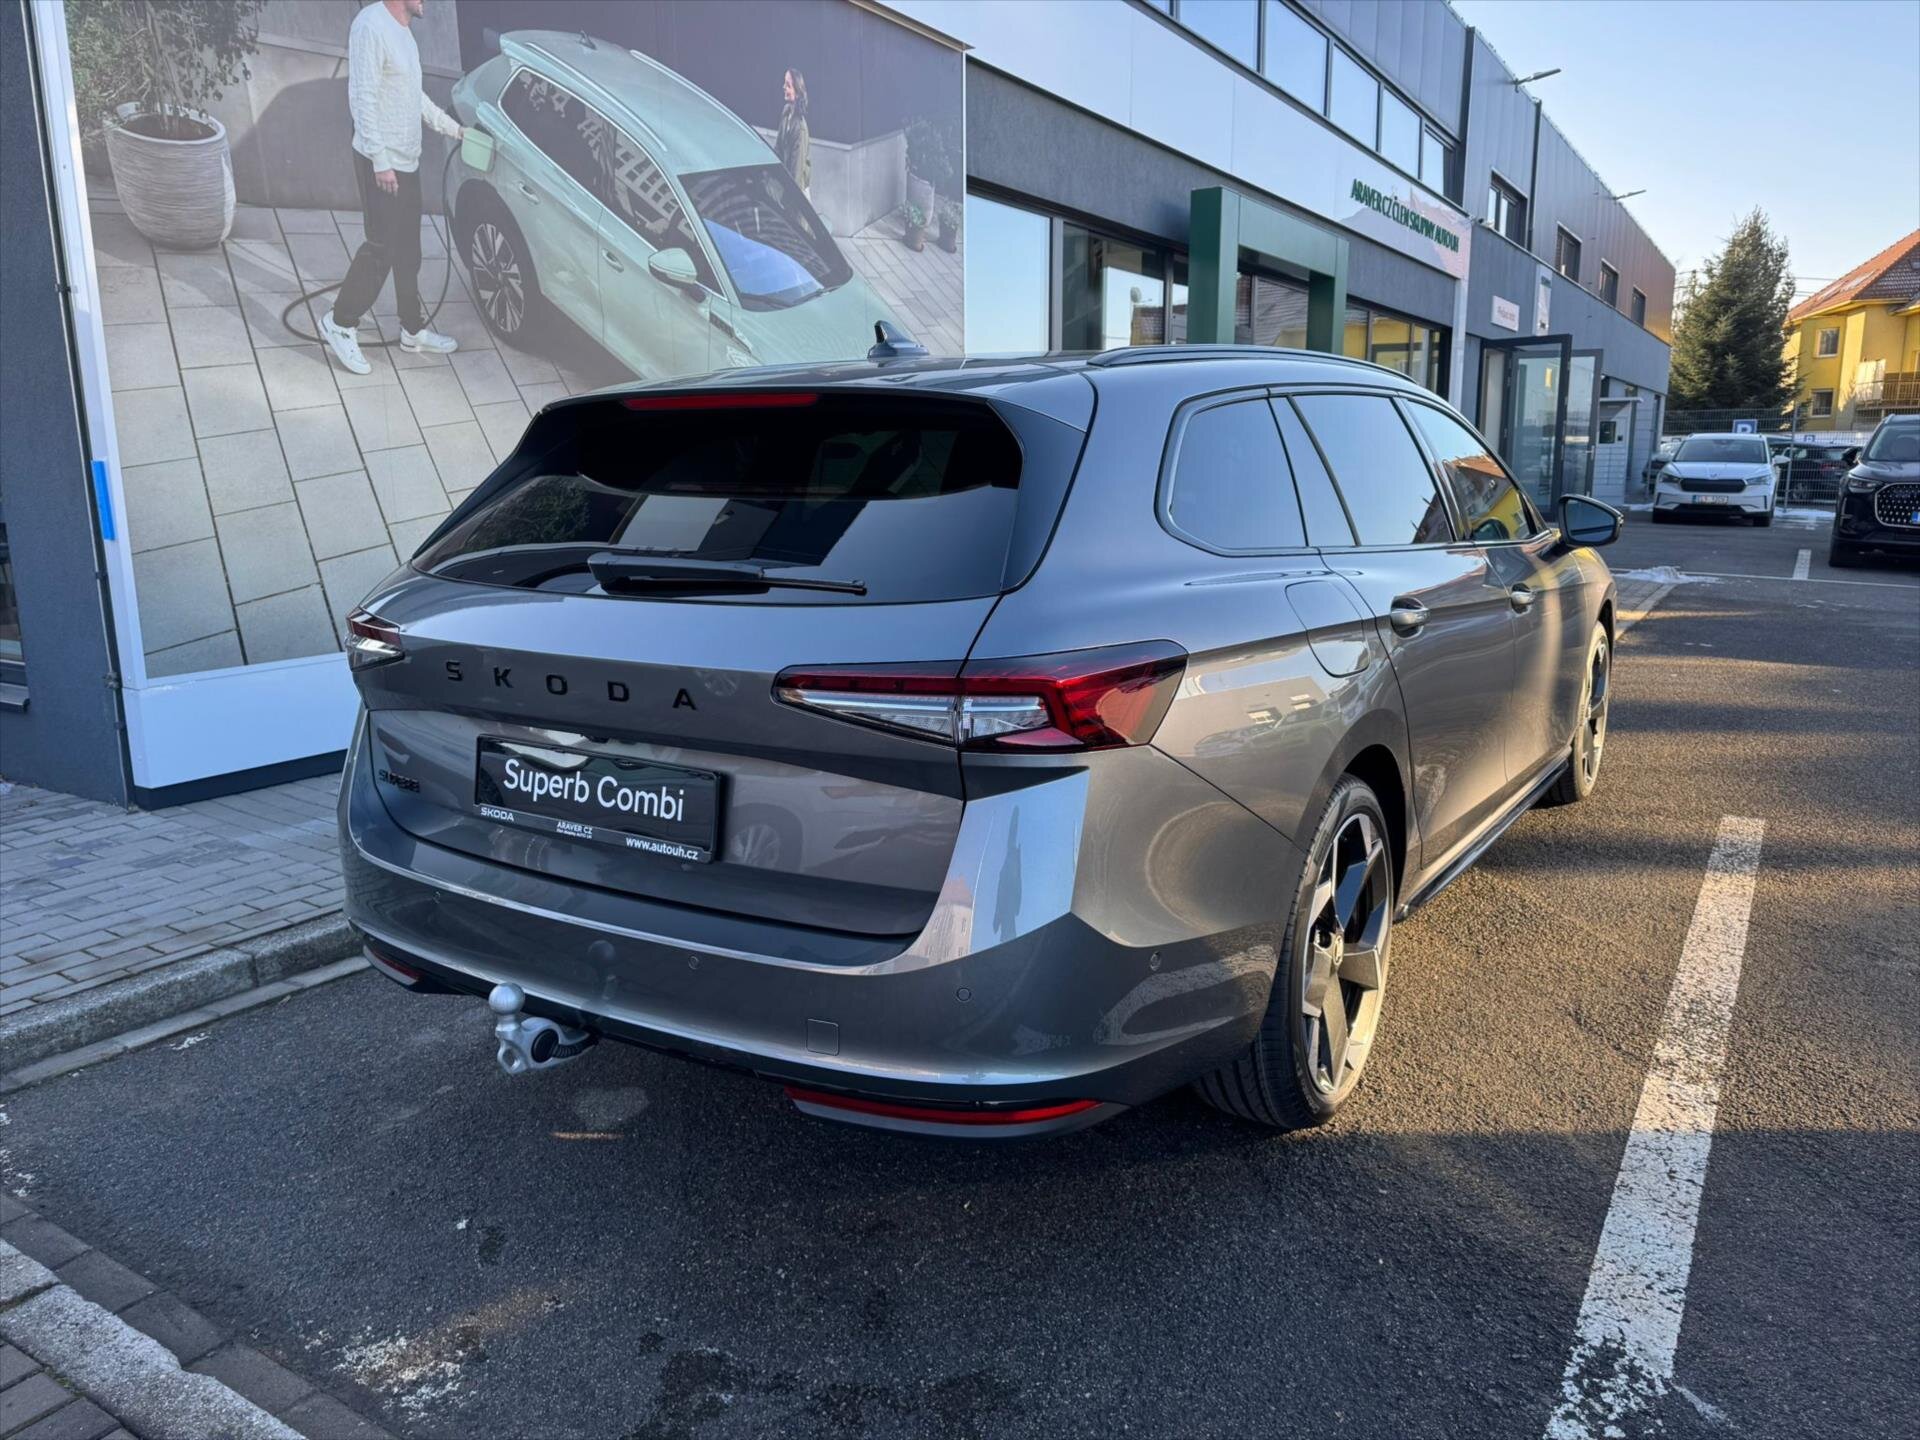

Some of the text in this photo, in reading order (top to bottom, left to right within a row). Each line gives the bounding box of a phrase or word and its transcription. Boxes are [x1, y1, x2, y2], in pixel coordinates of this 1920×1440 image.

[1350, 178, 1382, 213] ARAVER
[1382, 195, 1392, 218] CZ
[446, 661, 697, 710] SKODA
[503, 758, 685, 821] Superb Combi
[480, 807, 514, 822] SKODA
[557, 821, 583, 833] ARAVER
[626, 837, 698, 860] www.autouh.cz
